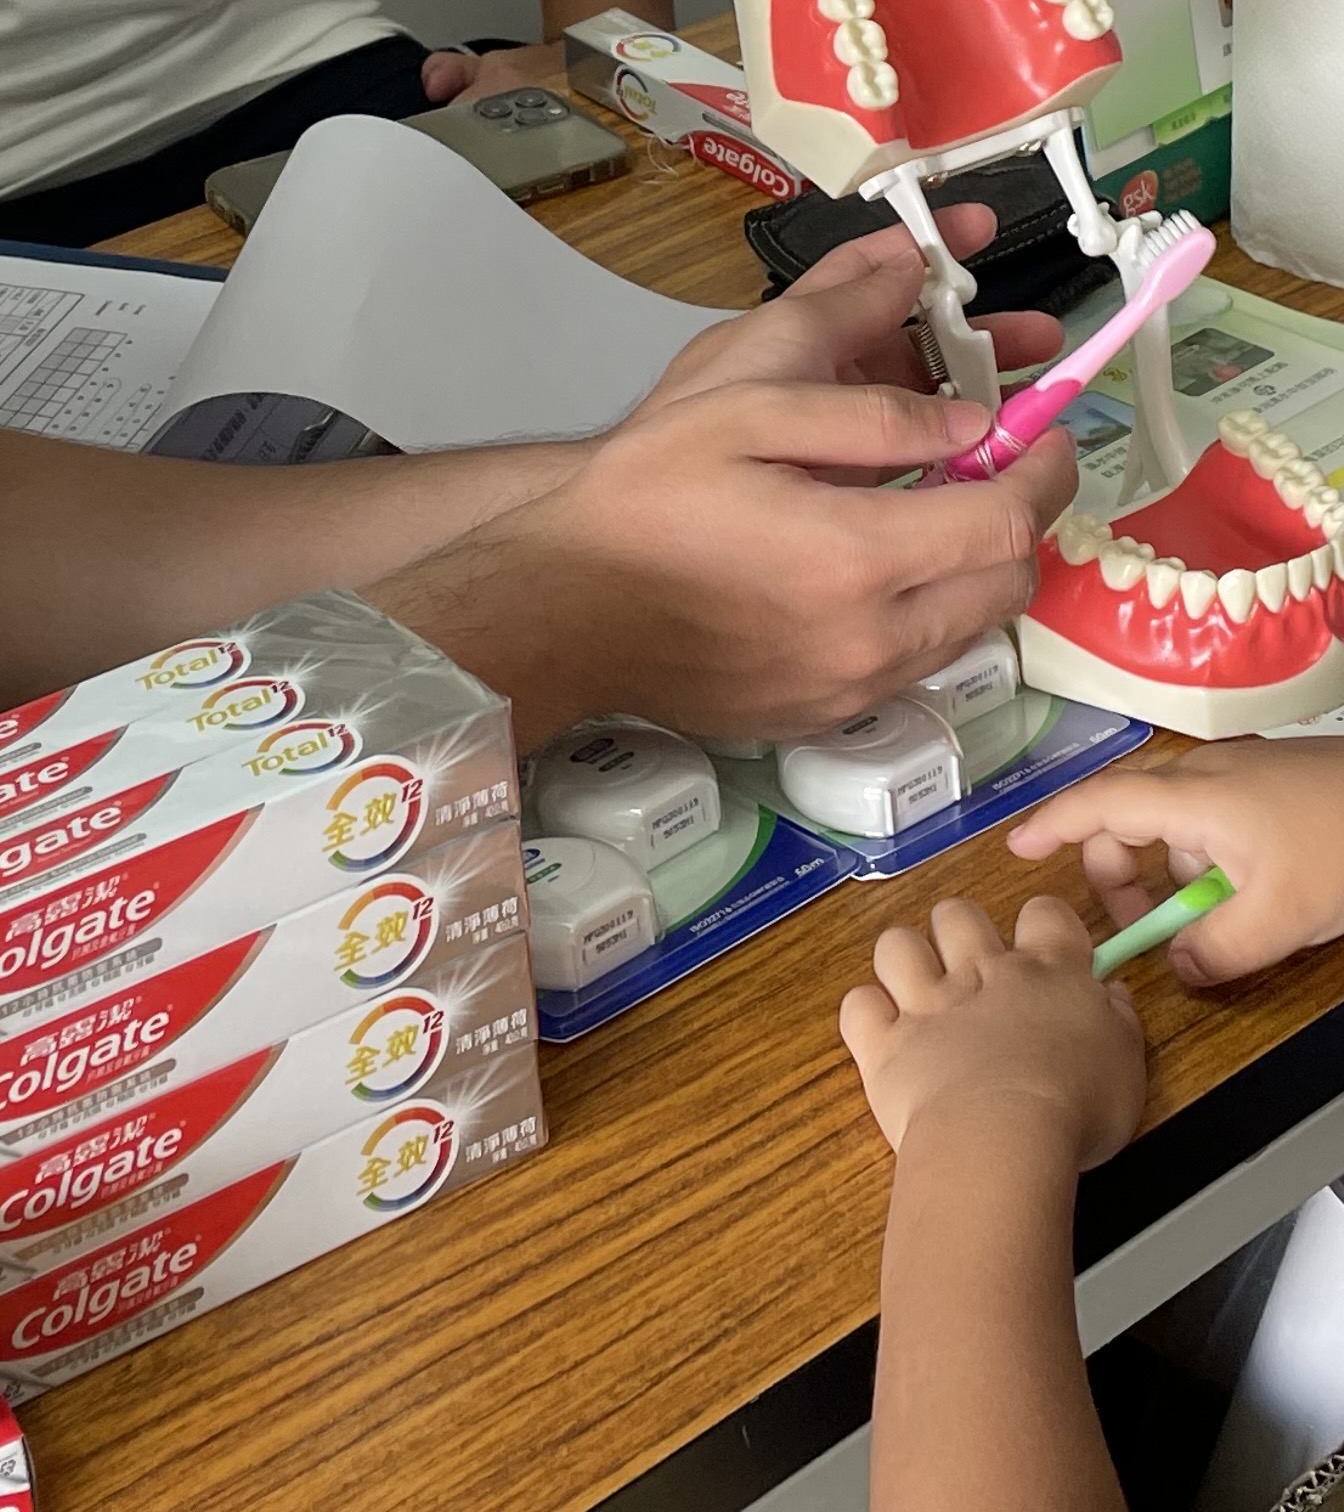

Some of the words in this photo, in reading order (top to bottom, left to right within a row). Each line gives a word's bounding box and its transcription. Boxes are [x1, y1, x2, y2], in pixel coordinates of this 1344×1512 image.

[702, 135, 791, 199] Colgate
[135, 649, 219, 692] Total
[186, 687, 272, 733] Total
[240, 731, 329, 778] Total
[321, 791, 398, 852] 全效
[401, 778, 424, 803] 12
[333, 909, 410, 972] 全效
[411, 896, 435, 922] 12
[344, 1027, 420, 1084] 全效
[421, 1009, 445, 1037] 12
[357, 1138, 428, 1193] 全效
[431, 1119, 456, 1146] 12
[10, 1240, 200, 1352] Colgate
